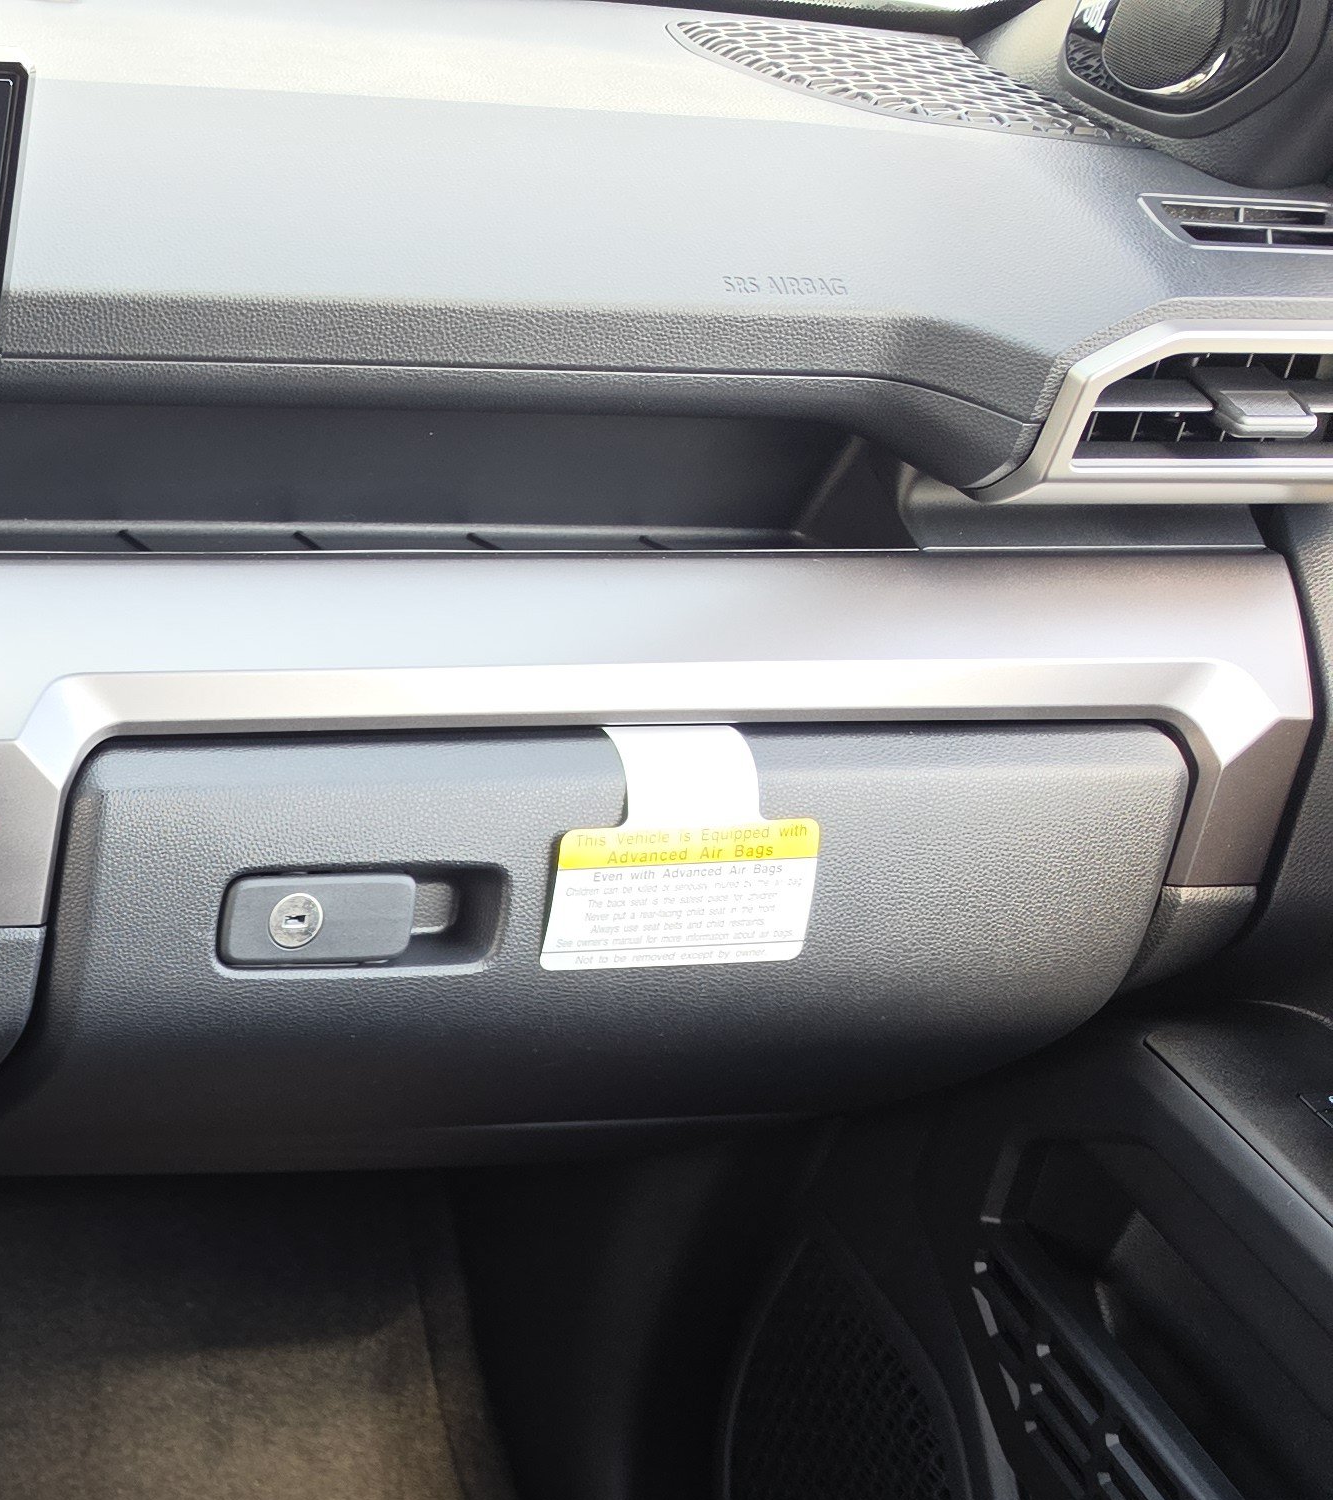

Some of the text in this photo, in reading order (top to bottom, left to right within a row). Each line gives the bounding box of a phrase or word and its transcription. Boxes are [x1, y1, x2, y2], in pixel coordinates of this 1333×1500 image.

[722, 276, 848, 296] SRS AIRBAG
[577, 824, 807, 846] This Vehicle is Equipped with
[607, 845, 773, 864] Advanced Air Bags
[593, 864, 782, 882] Even with Advanced Air Bags
[575, 956, 593, 964] Not
[599, 956, 608, 964] to
[614, 953, 626, 963] be
[633, 951, 676, 962] removed
[681, 951, 713, 961] except
[718, 950, 729, 959] by
